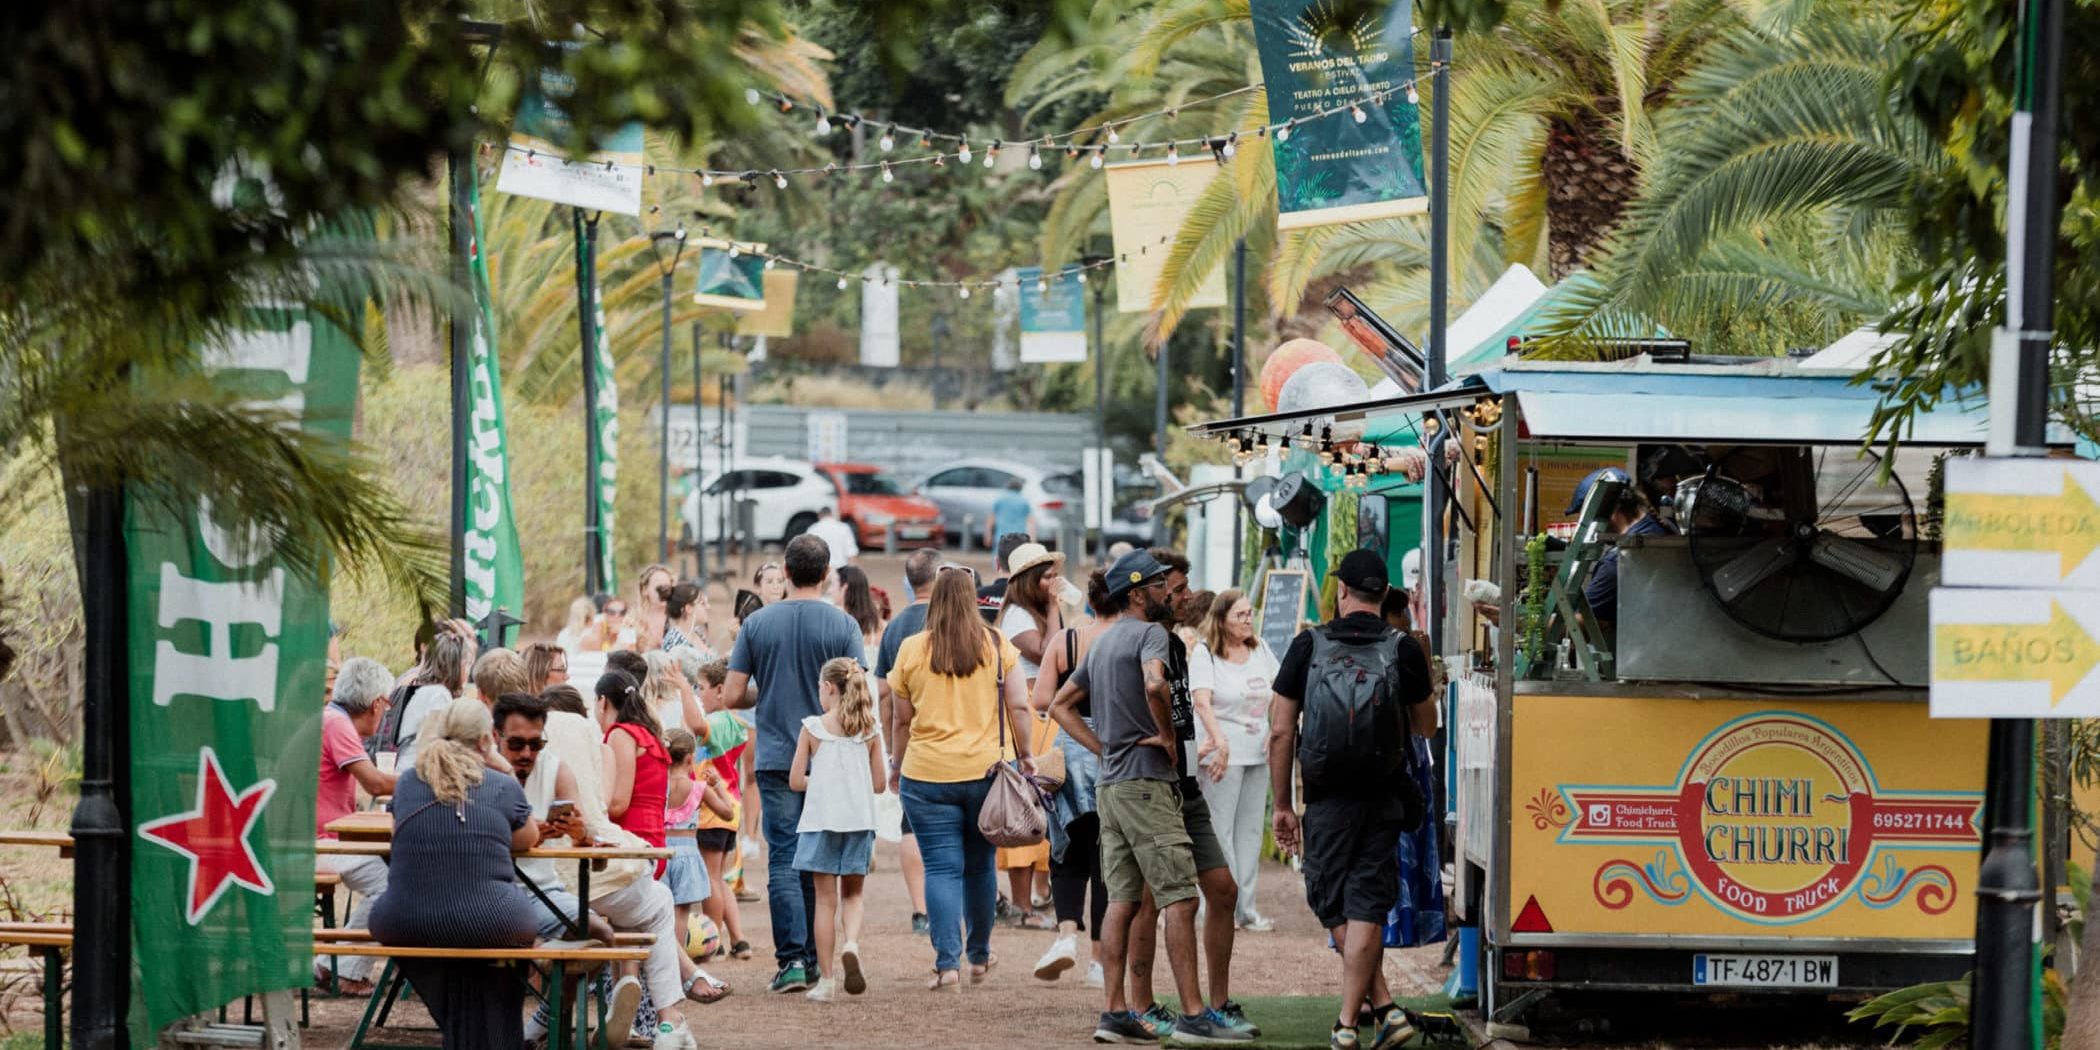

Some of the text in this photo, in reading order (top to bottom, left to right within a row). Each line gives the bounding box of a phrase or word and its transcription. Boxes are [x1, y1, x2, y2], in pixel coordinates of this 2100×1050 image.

[1289, 58, 1335, 72] VERANOS
[1336, 56, 1356, 67] DEL
[1294, 89, 1324, 100] TEATRO
[1324, 88, 1331, 97] A
[1332, 85, 1356, 95] CIELO
[1952, 629, 2075, 664] BAÑOS
[1700, 727, 1858, 785] Bocadillos Populares Argentinos
[1704, 776, 1814, 817] CHIMI
[1615, 816, 1677, 828] Food Truck
[1873, 813, 1964, 829] 695271744
[1704, 824, 1850, 865] CHURRI
[1718, 878, 1841, 912] FOOD TRUCK
